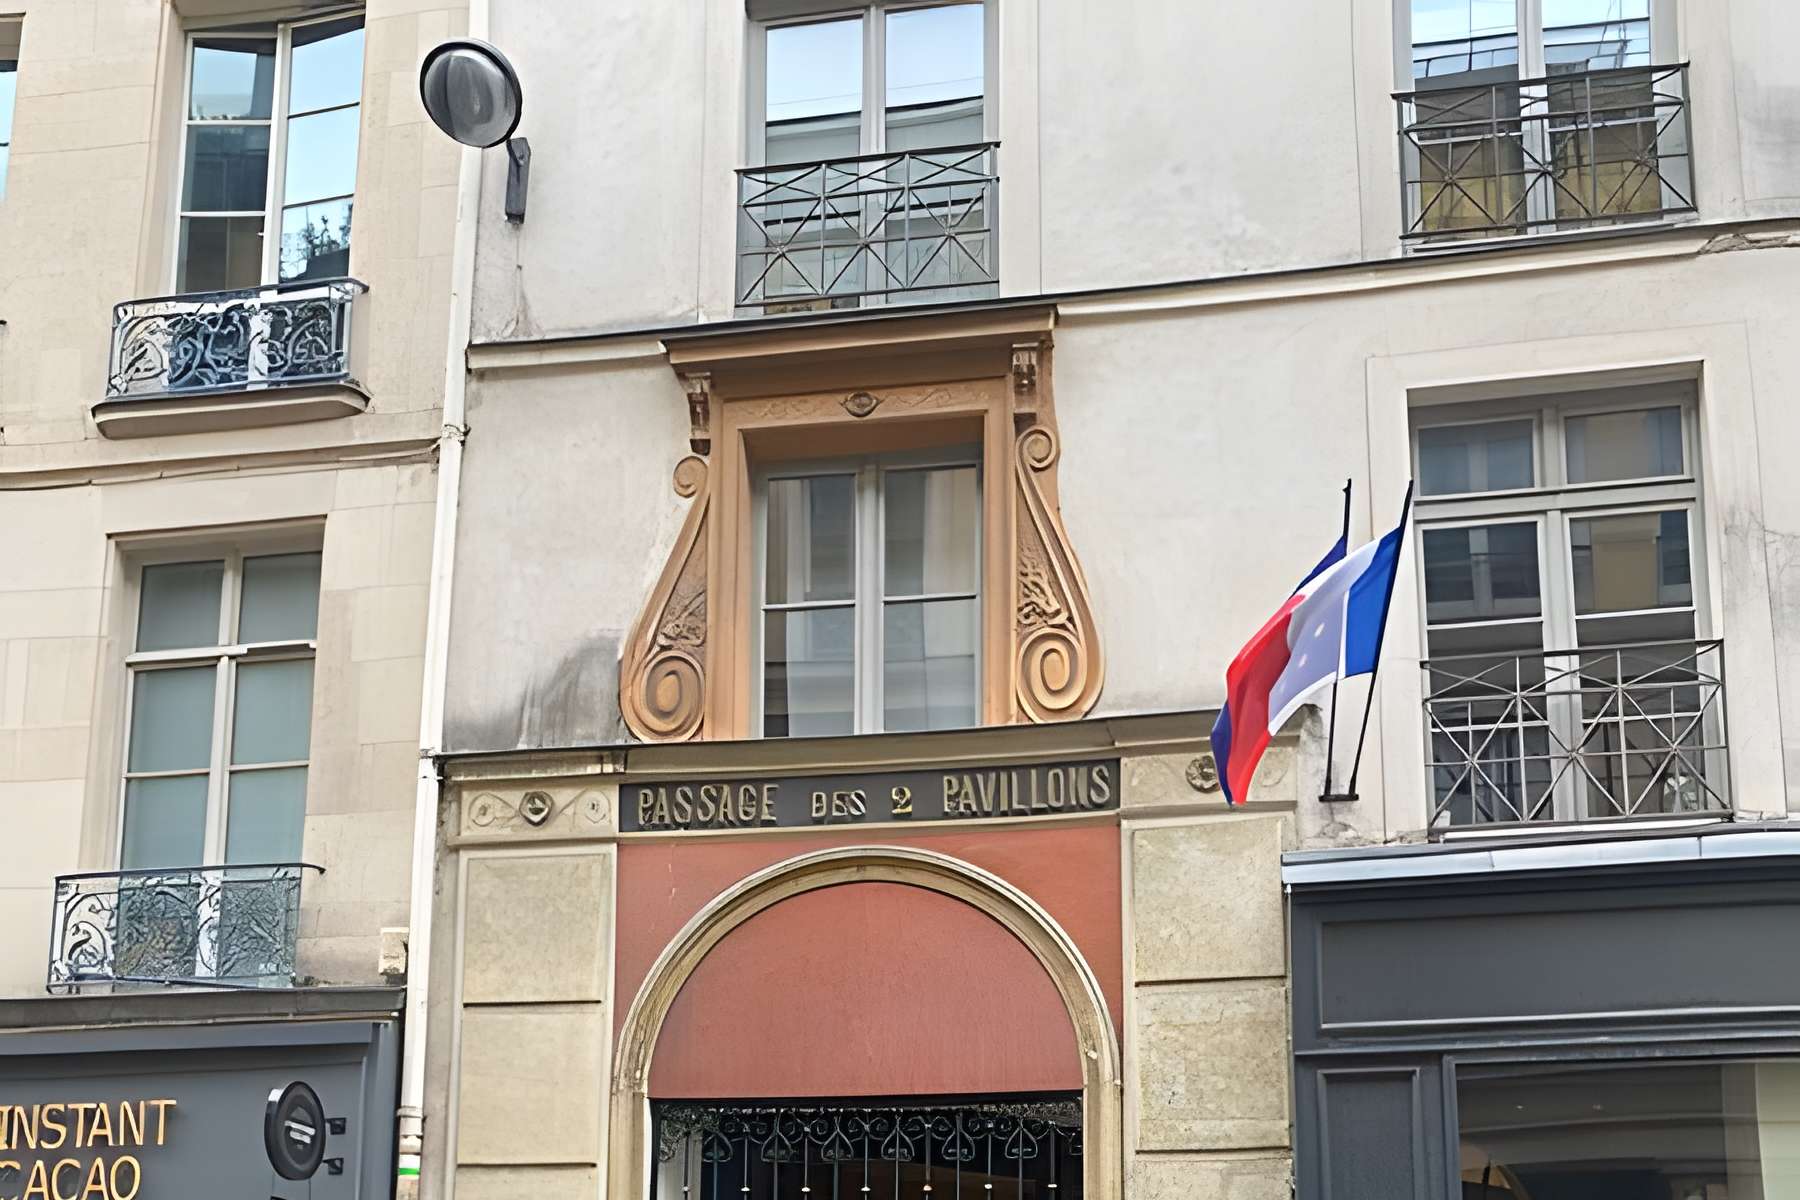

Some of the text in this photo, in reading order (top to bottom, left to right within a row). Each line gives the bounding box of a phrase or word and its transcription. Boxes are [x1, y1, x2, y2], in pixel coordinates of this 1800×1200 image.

[638, 765, 1111, 825] PASSAGE DES 2 PAVILLONS
